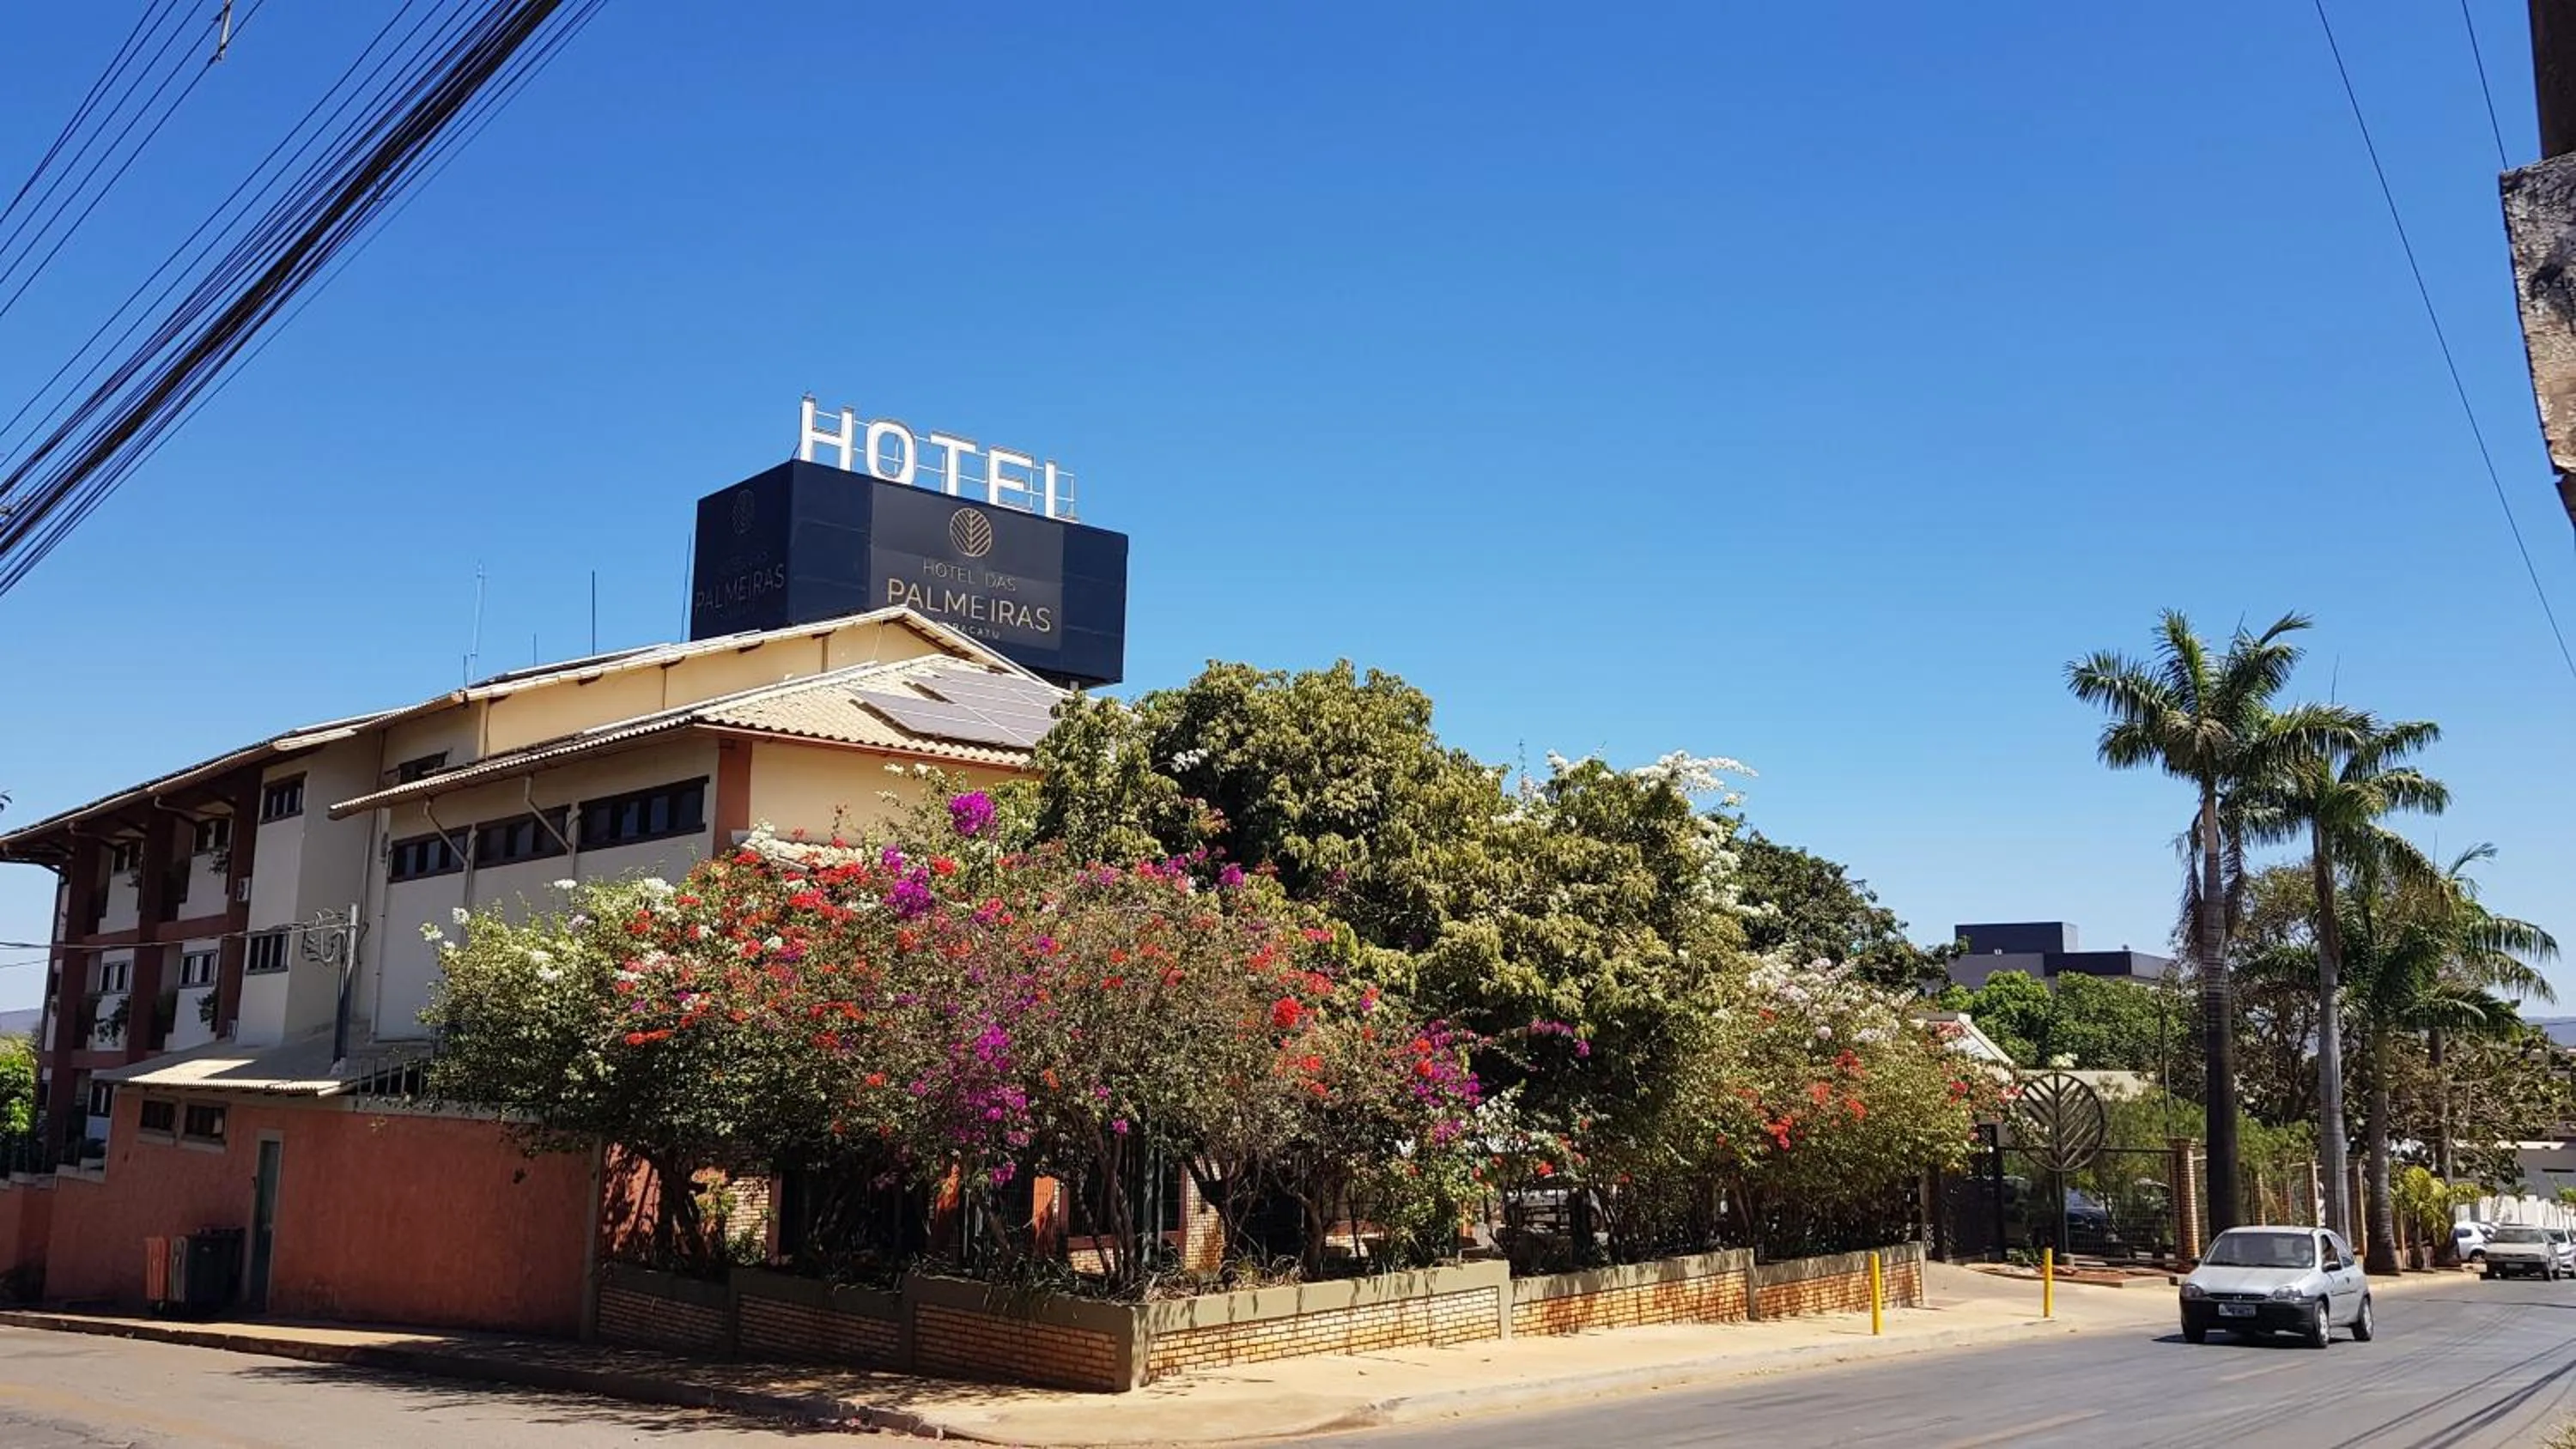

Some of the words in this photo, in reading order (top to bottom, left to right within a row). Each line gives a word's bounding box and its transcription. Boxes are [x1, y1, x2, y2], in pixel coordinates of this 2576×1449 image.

[799, 396, 1079, 524] HOTEL
[695, 562, 785, 615] PALMEIRAS
[922, 558, 976, 585] HOTEL
[985, 573, 1018, 592] DAS
[887, 577, 1052, 634] PALMEIRAS
